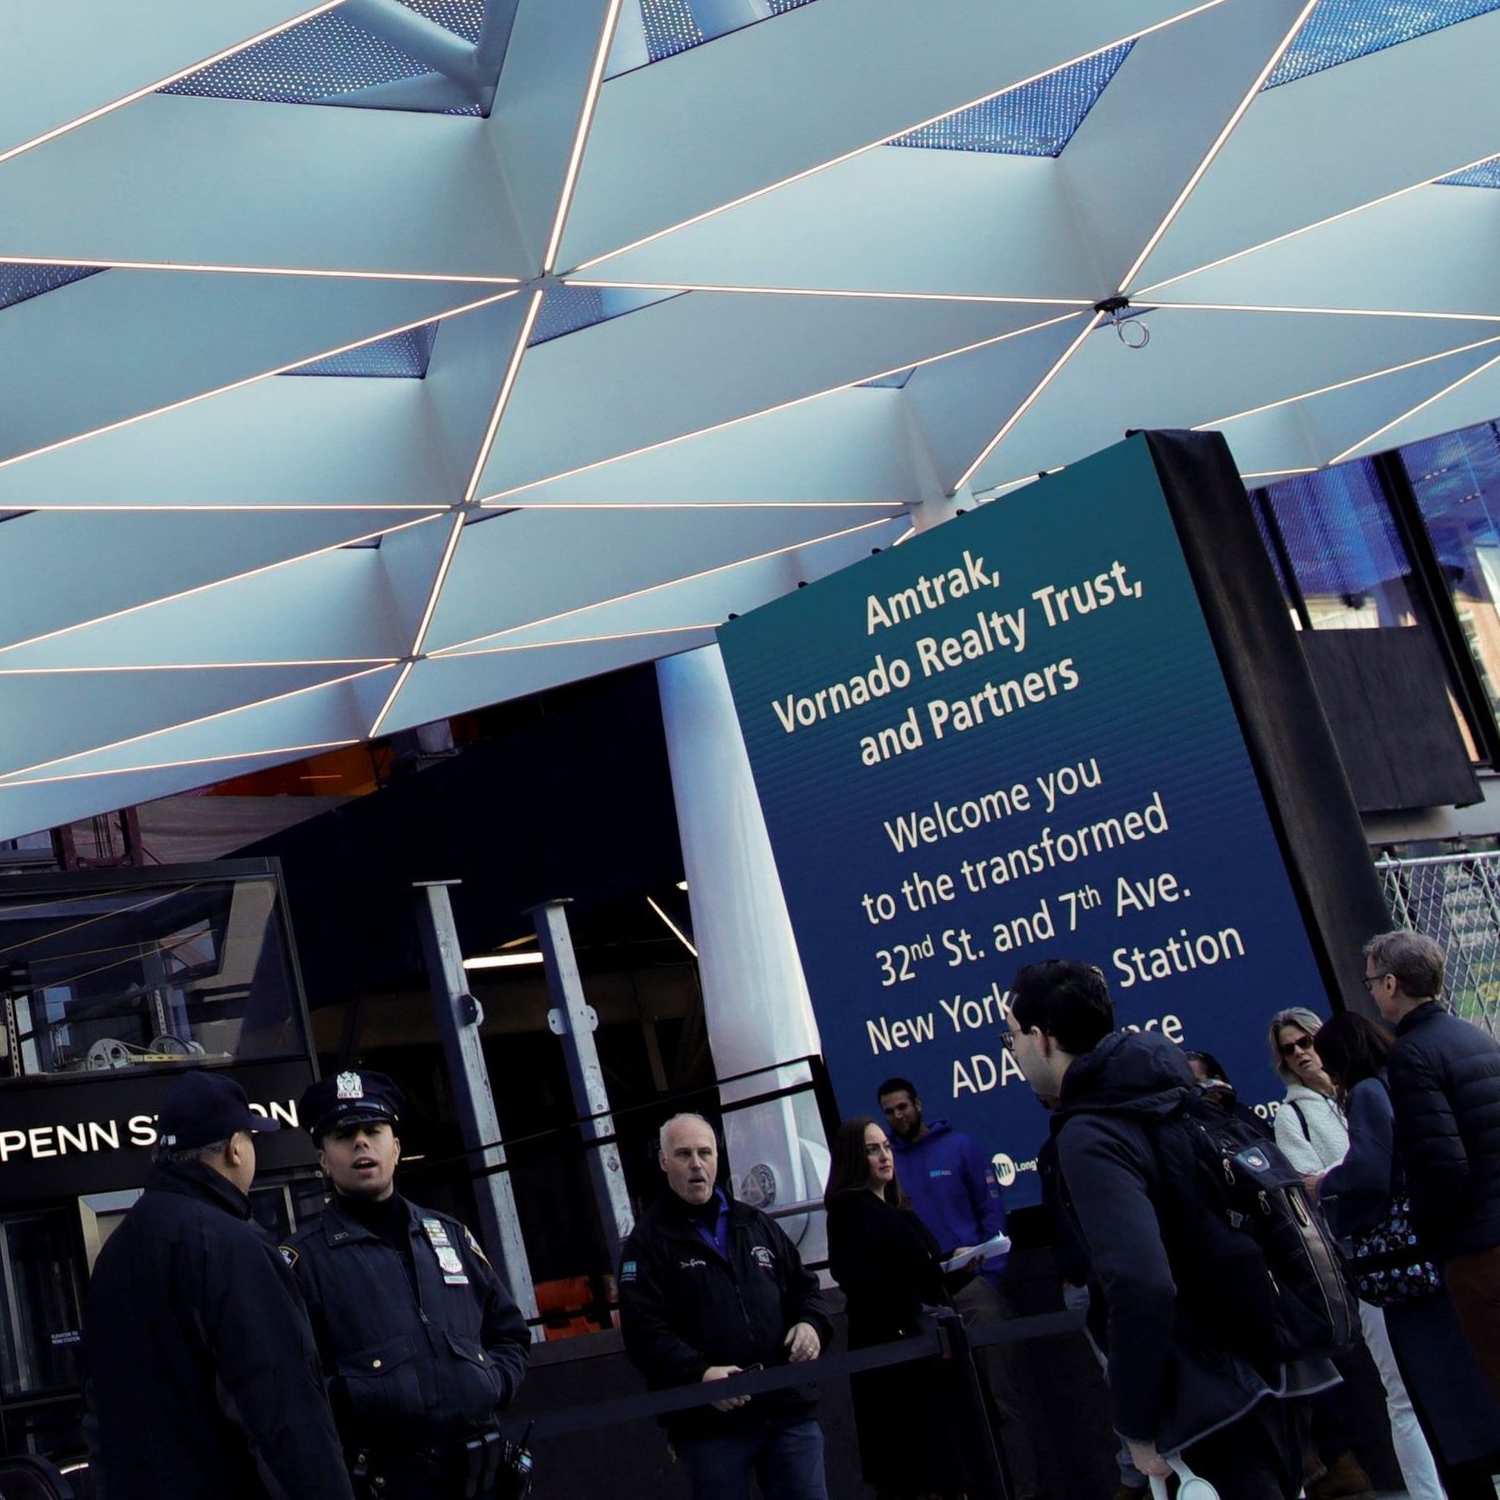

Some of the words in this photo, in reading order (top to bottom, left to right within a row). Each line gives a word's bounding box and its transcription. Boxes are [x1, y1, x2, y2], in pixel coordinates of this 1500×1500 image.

[772, 654, 910, 733] Vornado
[916, 607, 1026, 676] Realty
[1032, 560, 1143, 627] Trust,
[867, 550, 1001, 635] Amtrak,
[860, 708, 923, 766] and
[931, 655, 1079, 739] Partners
[861, 893, 896, 924] to
[901, 868, 955, 912] the
[960, 791, 1169, 893] transformed
[883, 785, 1031, 853] Welcome
[1037, 758, 1102, 813] you
[876, 934, 935, 986] 32nd
[942, 929, 985, 967] St.
[993, 900, 1055, 952] and
[1058, 884, 1102, 931] 7th
[1117, 873, 1192, 917] Ave.
[866, 1012, 934, 1055] New
[939, 982, 1012, 1034] York
[1113, 928, 1245, 988] Station
[953, 1047, 1026, 1098] ADA
[1015, 1160, 1037, 1173] Long
